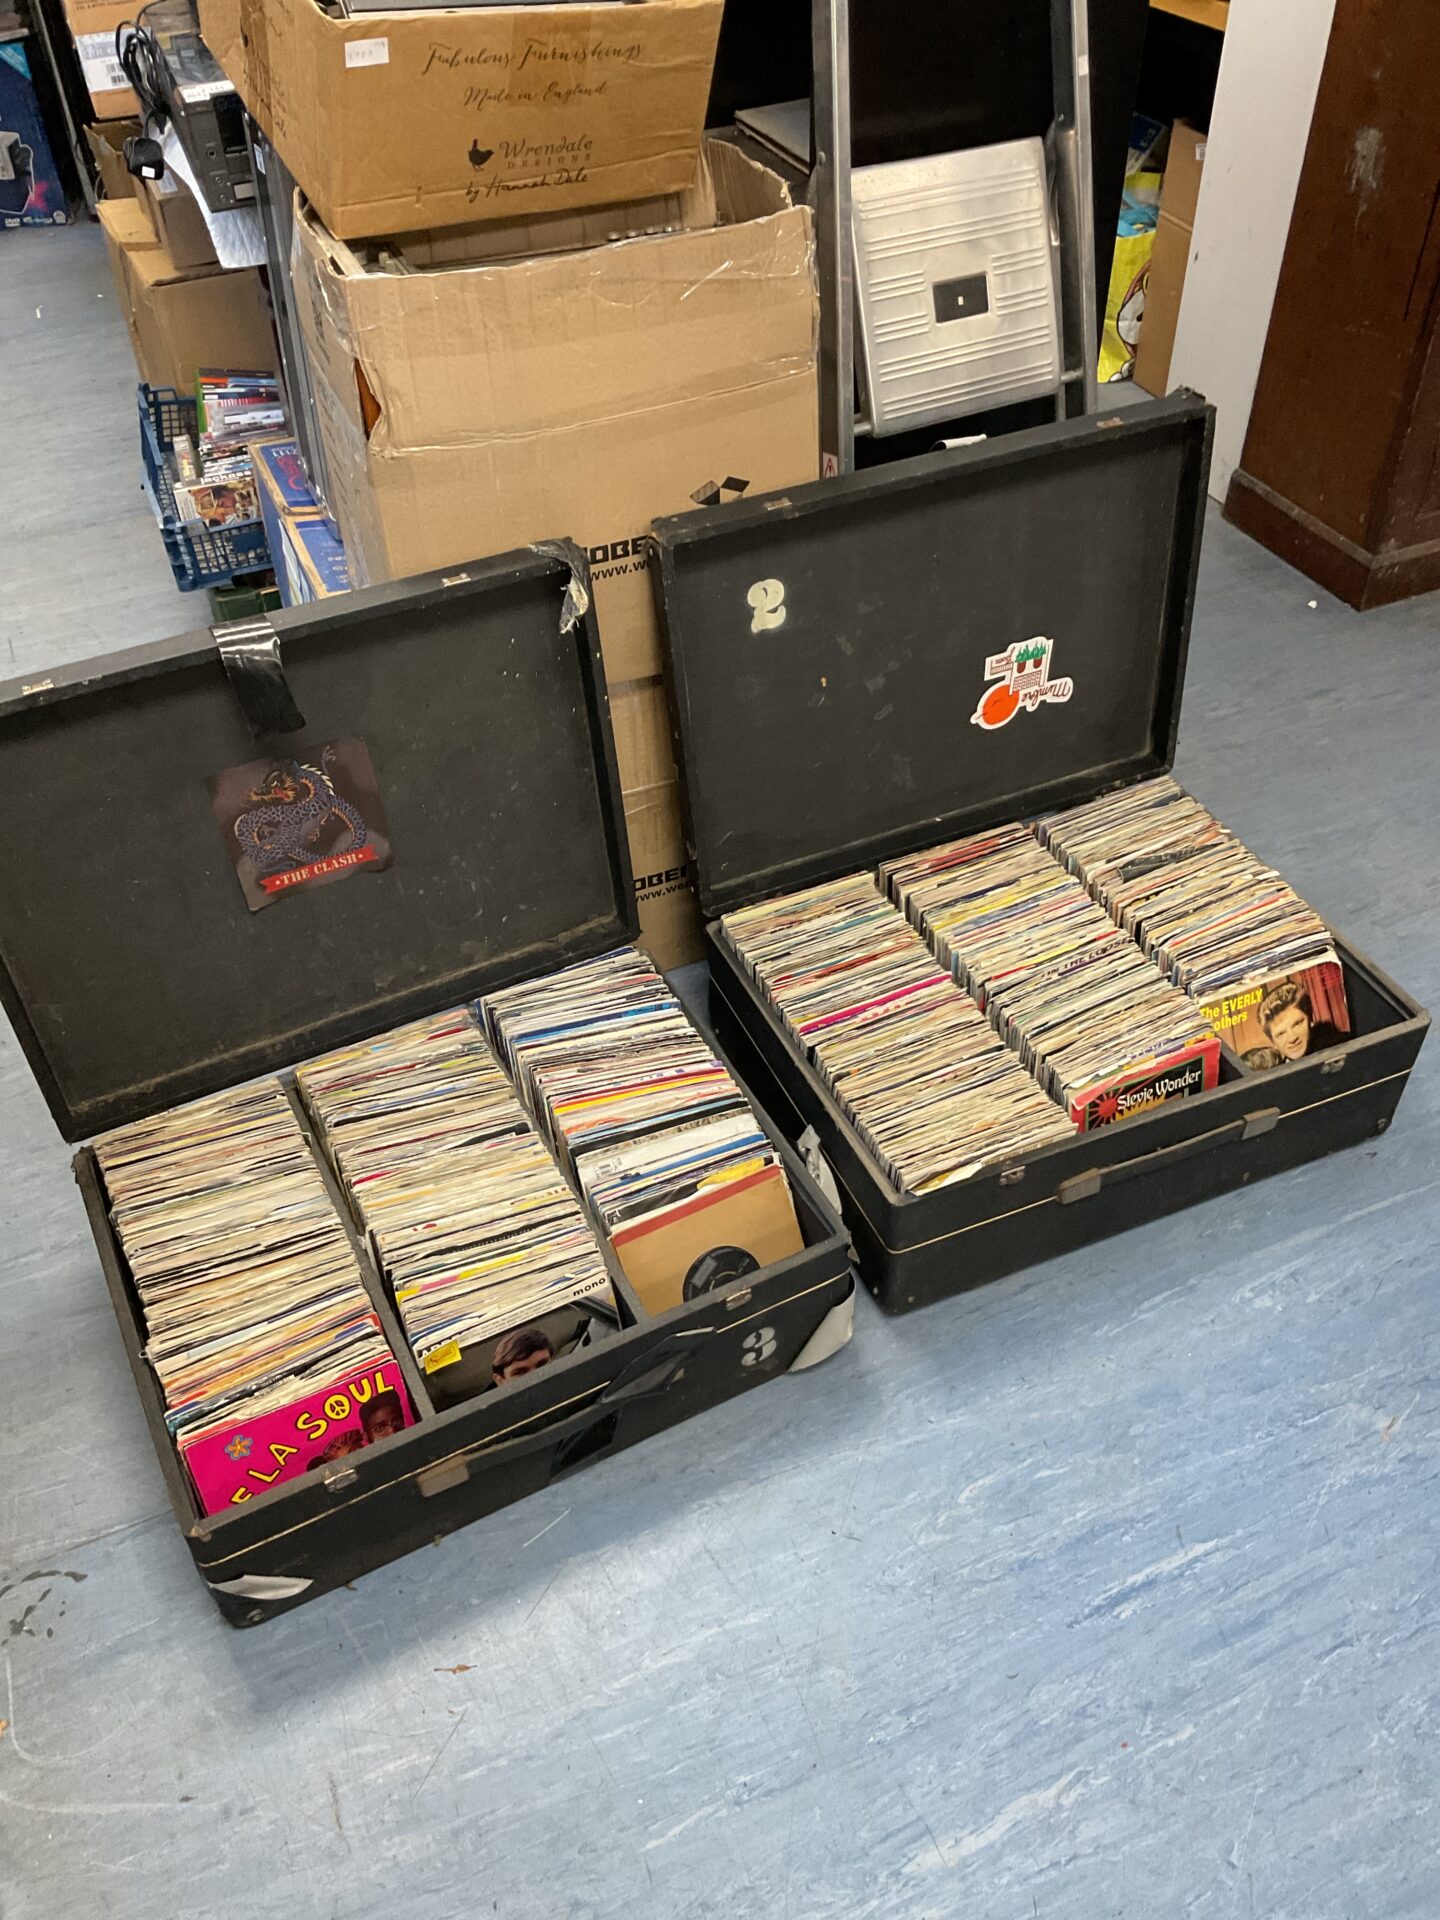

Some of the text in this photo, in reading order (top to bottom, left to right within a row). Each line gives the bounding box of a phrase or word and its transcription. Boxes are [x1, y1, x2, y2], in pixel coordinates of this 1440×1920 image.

[516, 38, 641, 71] Furnishings
[464, 81, 607, 112] Made in England
[499, 133, 593, 158] Wrendale
[466, 167, 588, 204] by Hannah Dale
[747, 578, 786, 633] 2
[280, 852, 358, 886] THE CLASH
[1222, 989, 1263, 1015] EVERLY
[1213, 1011, 1249, 1032] others
[1154, 1066, 1202, 1097] Wonder
[572, 1277, 606, 1297] mono
[741, 1326, 777, 1367] 3
[296, 1371, 395, 1441] SOUL
